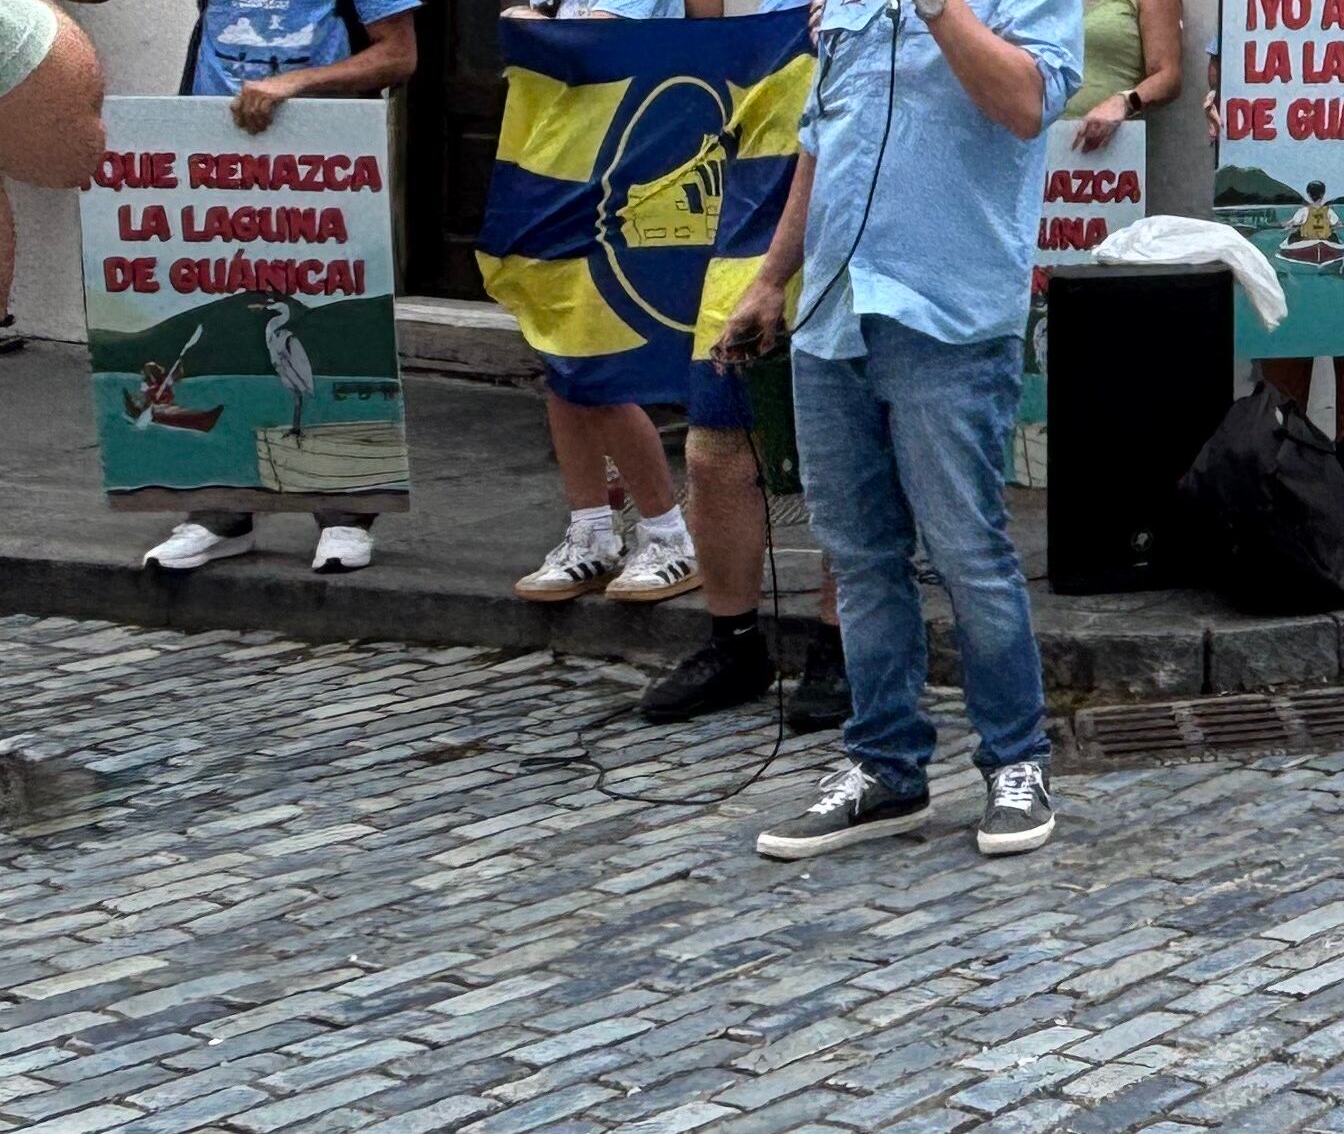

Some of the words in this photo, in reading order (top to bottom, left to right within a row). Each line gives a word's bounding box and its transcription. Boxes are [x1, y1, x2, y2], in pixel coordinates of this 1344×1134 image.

[1244, 41, 1292, 84] LA
[1226, 98, 1277, 141] DE
[80, 152, 178, 192] QUE
[188, 153, 382, 192] RENAZCA
[118, 204, 171, 242] LA
[181, 205, 347, 244] LAGUNA
[103, 256, 160, 293] DE
[169, 248, 365, 296] GUÁNICA!
